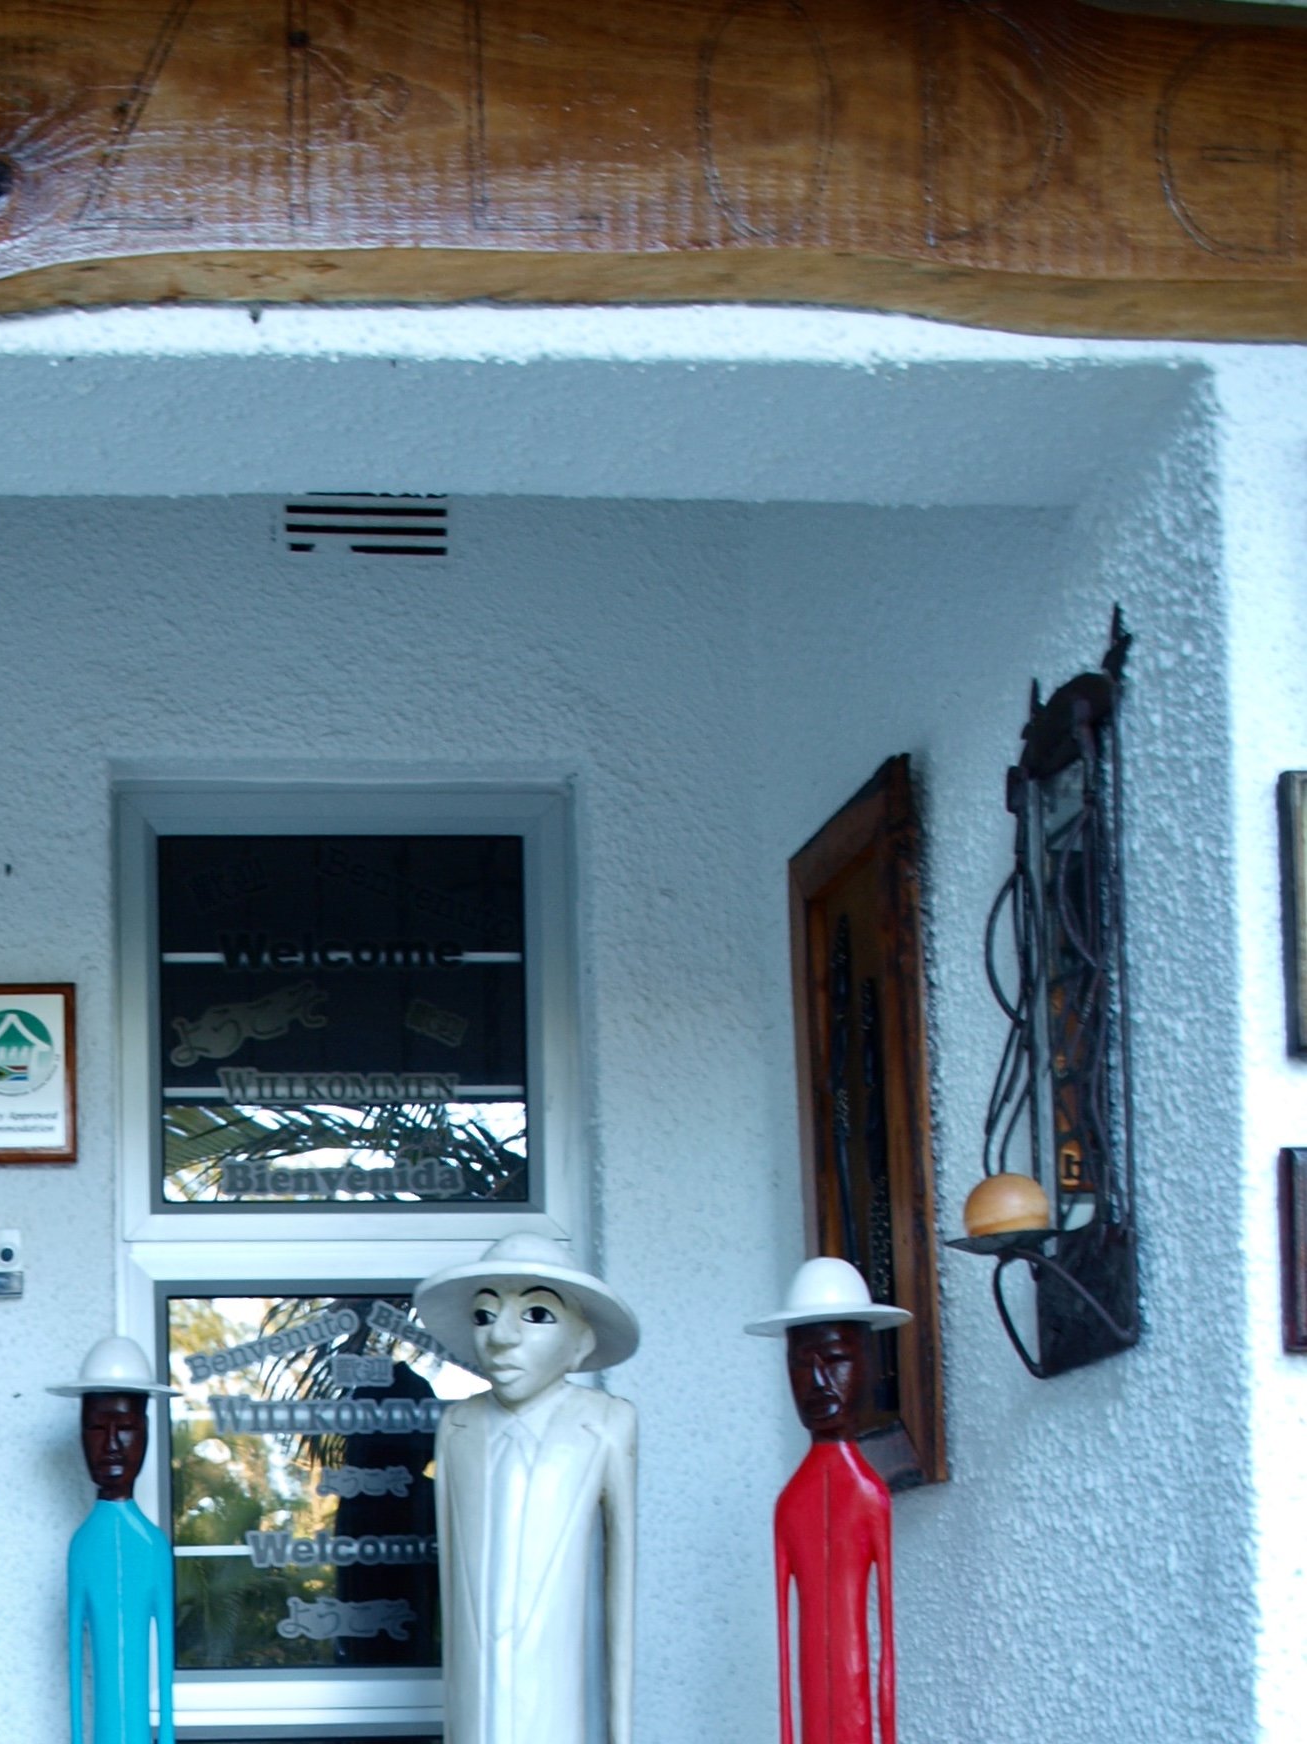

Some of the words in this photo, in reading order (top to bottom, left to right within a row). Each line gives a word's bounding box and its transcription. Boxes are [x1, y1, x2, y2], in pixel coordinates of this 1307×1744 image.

[219, 931, 462, 969] Welcome
[224, 1163, 461, 1194] Bienvenida
[189, 1309, 355, 1380] Benvenuto
[209, 1396, 446, 1433] WILLKOMM
[318, 1467, 412, 1496] ようこそ
[279, 1599, 417, 1638] ようこそ
